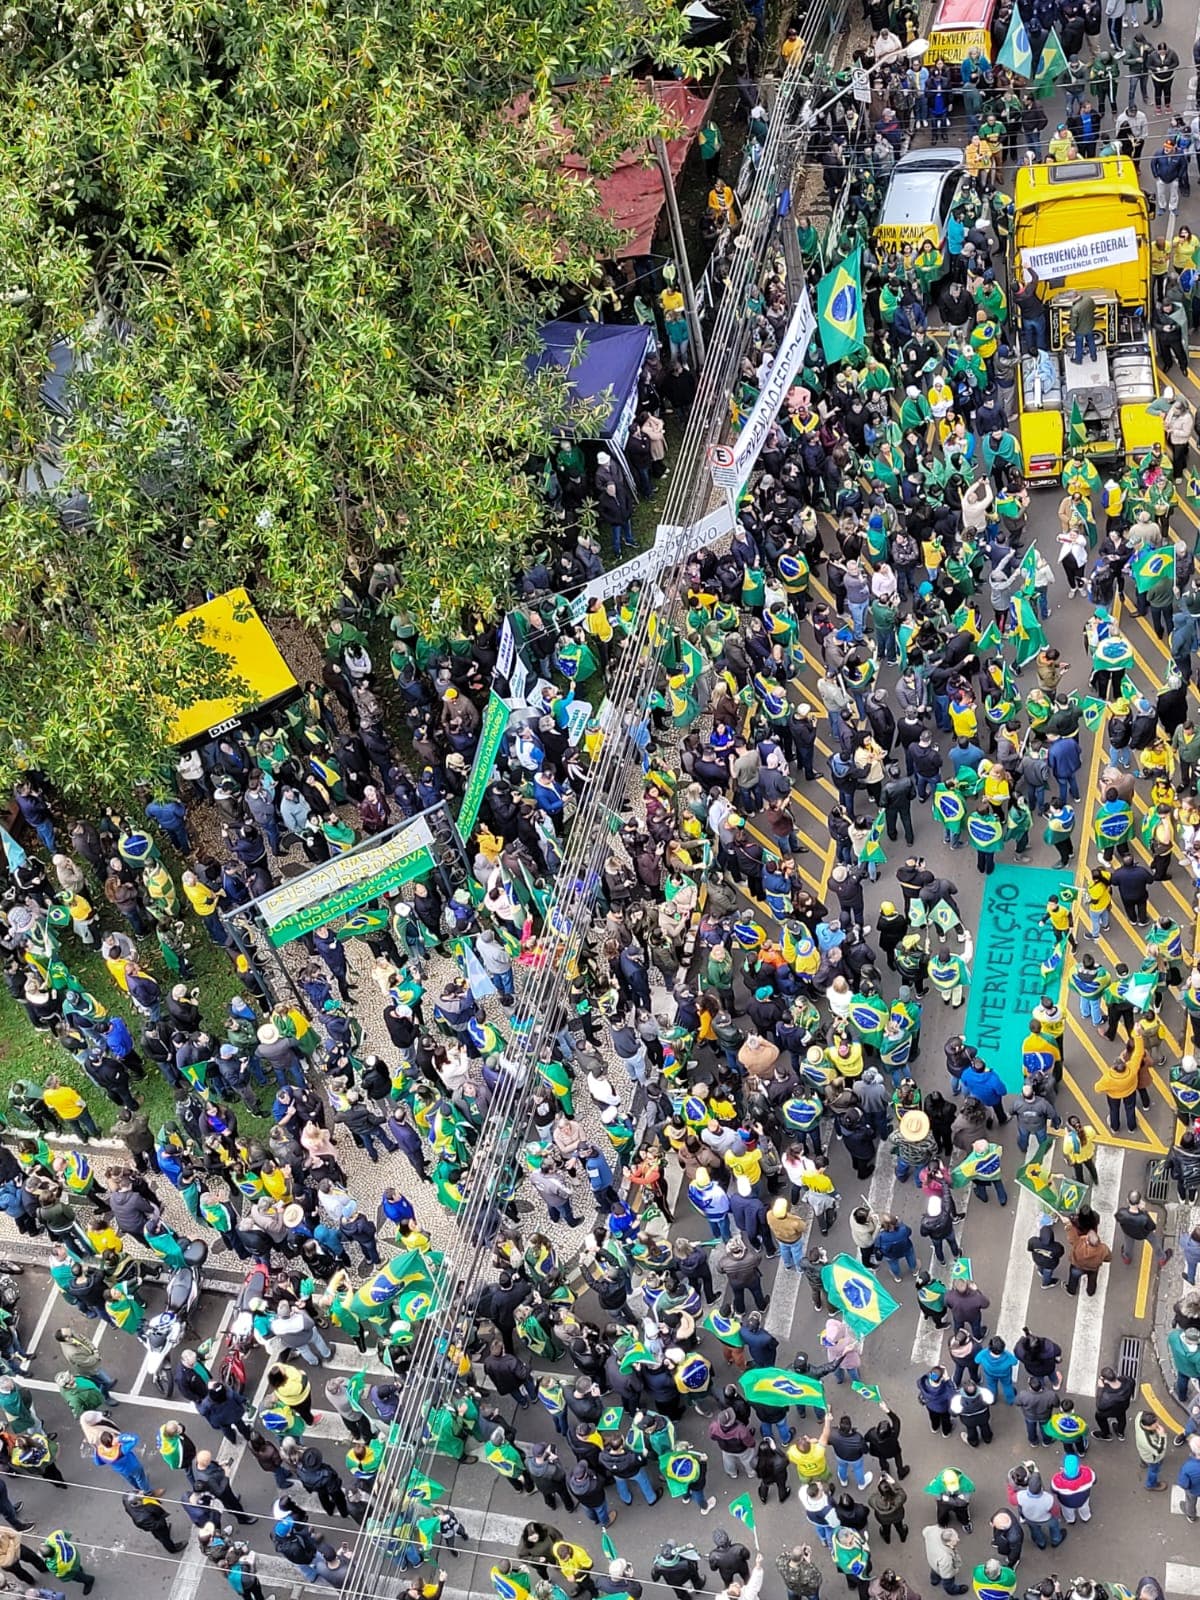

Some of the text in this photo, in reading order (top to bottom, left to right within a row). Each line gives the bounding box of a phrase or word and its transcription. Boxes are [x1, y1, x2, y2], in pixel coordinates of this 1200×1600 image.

[1029, 236, 1129, 267] INTERVENÇÃO FEDERAL
[1052, 255, 1110, 273] RESISTÊNCIA CIVIL
[715, 449, 727, 463] E
[600, 560, 640, 585] TODO
[211, 719, 239, 737] DHL
[268, 908, 322, 936] JUNTOS
[386, 850, 428, 875] NOVA
[978, 883, 1020, 1051] INTERVENÇÃO
